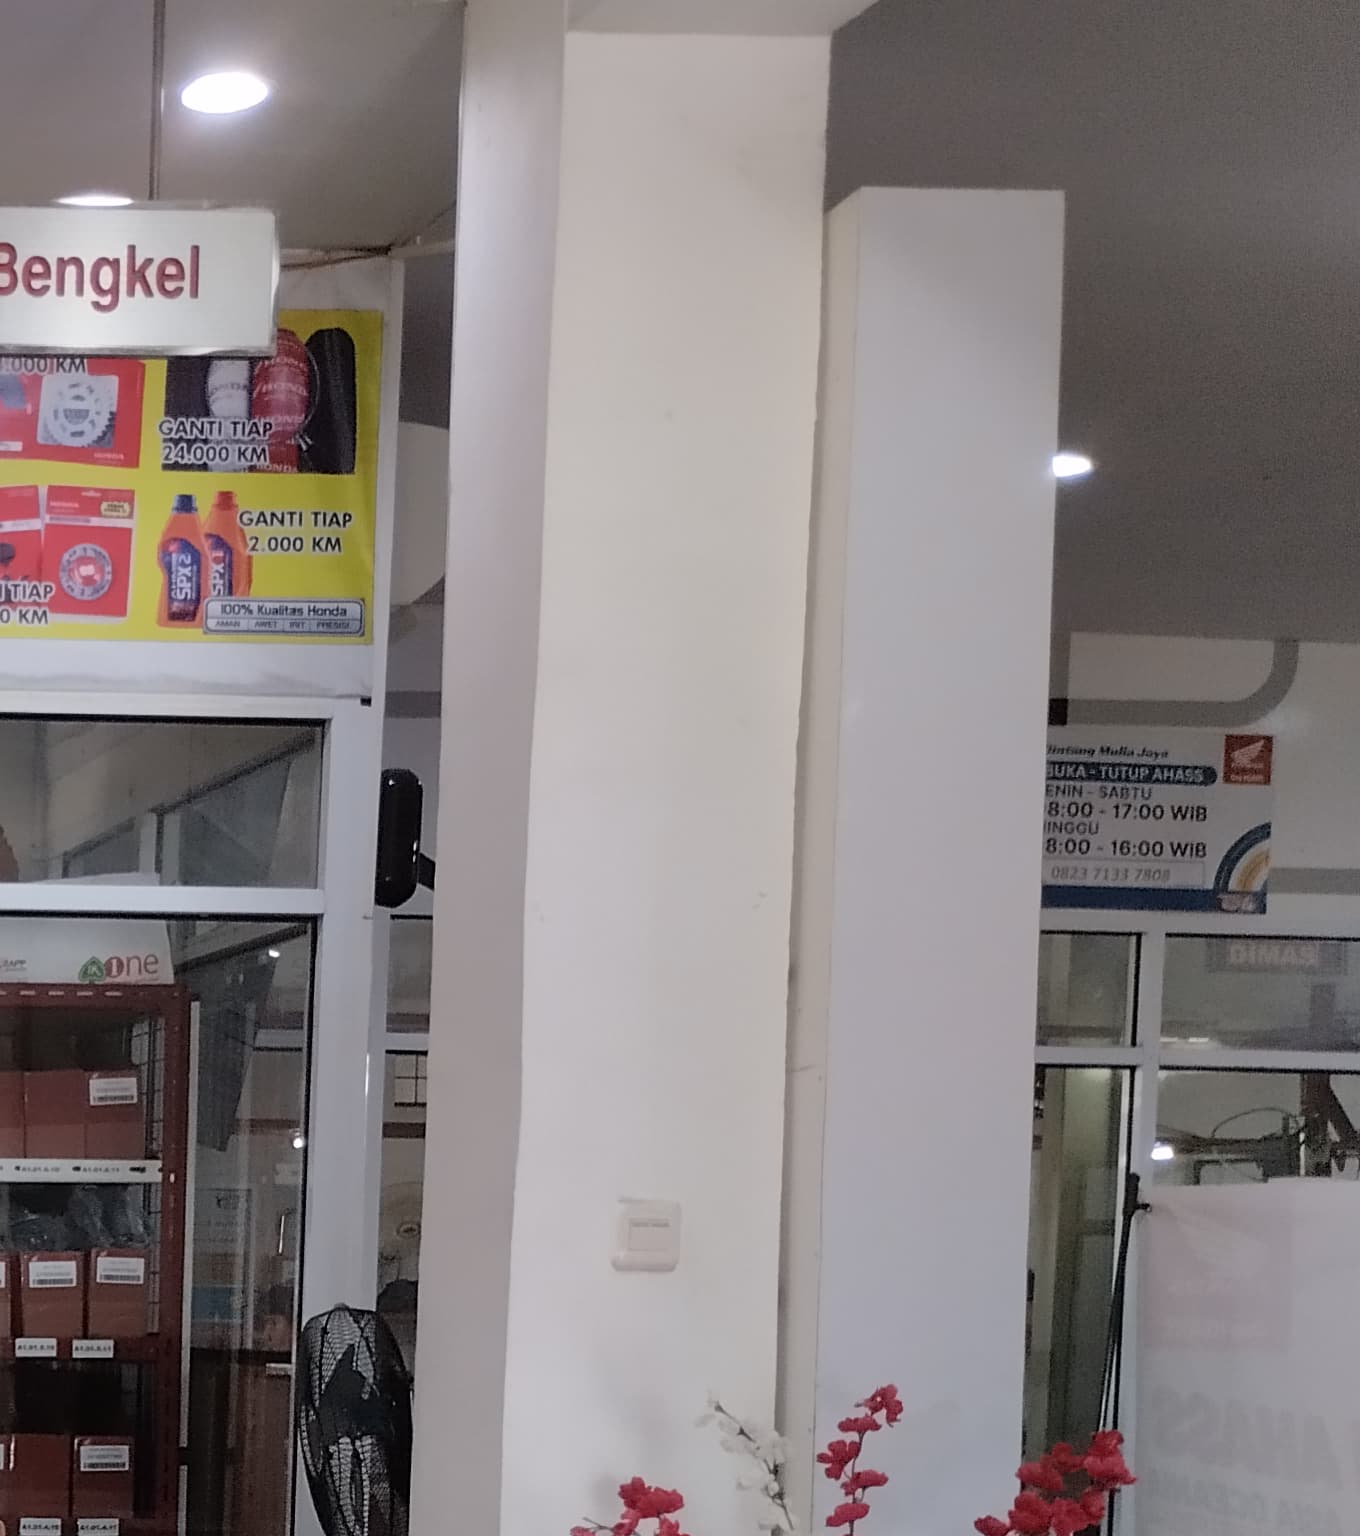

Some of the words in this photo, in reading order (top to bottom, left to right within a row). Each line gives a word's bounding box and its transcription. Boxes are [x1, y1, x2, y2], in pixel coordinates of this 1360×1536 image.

[56, 358, 85, 373] KM
[159, 420, 223, 437] GANTI
[231, 421, 273, 438] TIAP
[162, 446, 230, 463] 24.000
[238, 447, 268, 463] KM
[239, 511, 304, 528] GANTI
[311, 512, 352, 528] TIAP
[248, 536, 304, 553] 2.000
[312, 537, 342, 553] KM
[13, 584, 53, 599] TIAP
[19, 608, 48, 624] KM
[220, 604, 253, 616] 100%
[257, 604, 304, 617] Kualitas
[307, 605, 347, 617] Honda
[1047, 745, 1096, 757] intang
[1099, 765, 1149, 781] TUTUP
[1153, 767, 1204, 782] AHASS
[1046, 786, 1083, 798] ENIN
[1099, 786, 1152, 800] SABTU
[1048, 802, 1093, 818] 8:00
[1112, 804, 1165, 821] 17:00
[1170, 806, 1208, 822] WIB
[1044, 821, 1099, 835] INGGU
[1046, 839, 1091, 855] 8:00
[1111, 840, 1163, 857] 16:00
[1169, 842, 1208, 859] WIB
